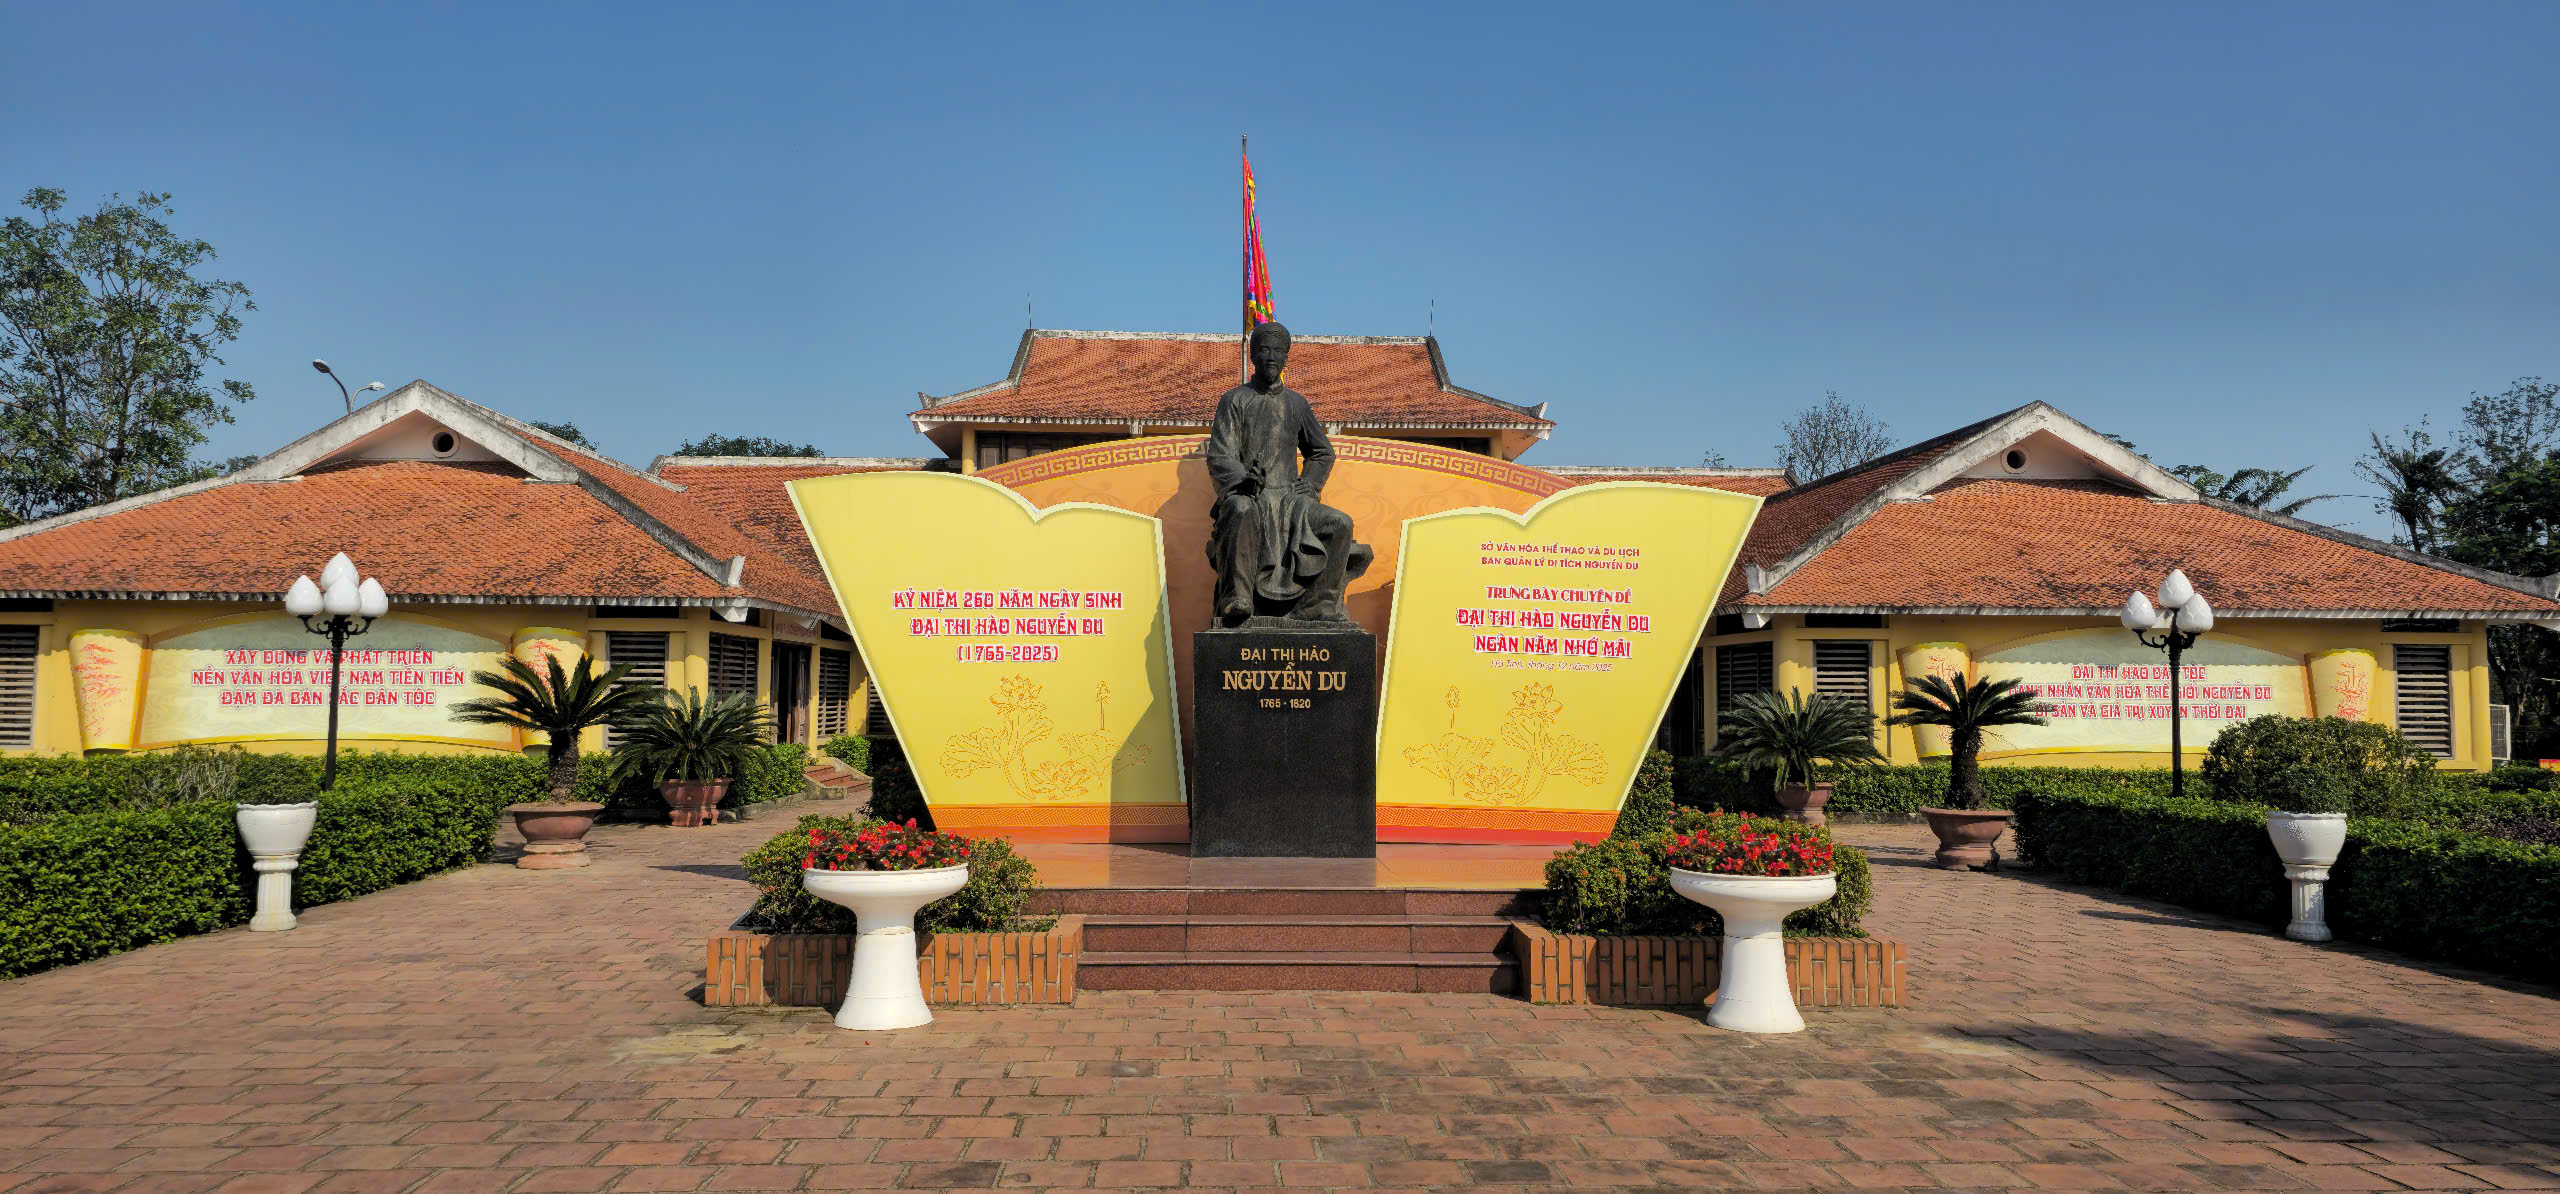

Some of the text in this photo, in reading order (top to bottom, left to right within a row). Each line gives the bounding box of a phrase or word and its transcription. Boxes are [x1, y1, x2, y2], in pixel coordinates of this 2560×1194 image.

[1497, 543, 1516, 551] VĂN
[1519, 543, 1539, 552] HÓA
[1588, 545, 1600, 555] VÀ
[1619, 548, 1639, 557] LỊCH
[1504, 556, 1532, 565] QUẢN
[1535, 557, 1545, 566] LÝ
[1560, 558, 1581, 567] TÍCH
[1584, 559, 1622, 569] NGUYỄN
[1626, 562, 1638, 570] DU
[894, 588, 1122, 612] KỶ NIỆM 260 NĂM NGÀY SINH
[1532, 586, 1558, 600] BÀY
[1561, 588, 1613, 603] CHUYÊN
[912, 613, 1104, 638] ĐẠI THI HÀO NGUYỄN DU
[1458, 608, 1648, 631] ĐẠI THI HÀO NGUYỄN DU
[957, 645, 1059, 661] (1765-2025)
[1476, 632, 1630, 656] NGÀN NĂM NHỚ MÃI
[226, 644, 432, 667] XÂY DỰNG VÀ PHÁT TRIỂN
[1241, 648, 1266, 664] ĐẠI
[1271, 648, 1294, 660] THI
[193, 666, 224, 684] NỀN
[231, 668, 263, 684] VĂN
[268, 667, 303, 684] HÓA
[350, 671, 383, 684] NAM
[389, 668, 424, 684] TIÊN
[430, 665, 464, 684] TIẾN
[1223, 662, 1346, 690] NGUYỄN DU
[2073, 664, 2206, 682] ĐẠI THI HÀO DÂ TỘC
[222, 688, 256, 708] ĐẬM
[262, 688, 284, 704] ĐÀ
[290, 687, 322, 704] BẢN
[365, 688, 397, 704] DÂN
[404, 688, 434, 708] TỘC
[2048, 682, 2082, 698] NHÂN
[2086, 682, 2111, 698] VĂN
[2115, 682, 2142, 698] HÓA
[2145, 682, 2170, 698] THẾ
[2203, 681, 2250, 699] NGUYỄN
[2255, 686, 2271, 699] DU
[1260, 698, 1281, 708] 1765
[1290, 698, 1311, 708] 1820
[2052, 701, 2076, 717] SẢN
[2080, 702, 2096, 717] VÀ
[2101, 702, 2120, 717] GIÁ
[2125, 704, 2144, 721] TRỊ
[2148, 704, 2187, 718] XUYN
[2191, 703, 2220, 718] THỜI
